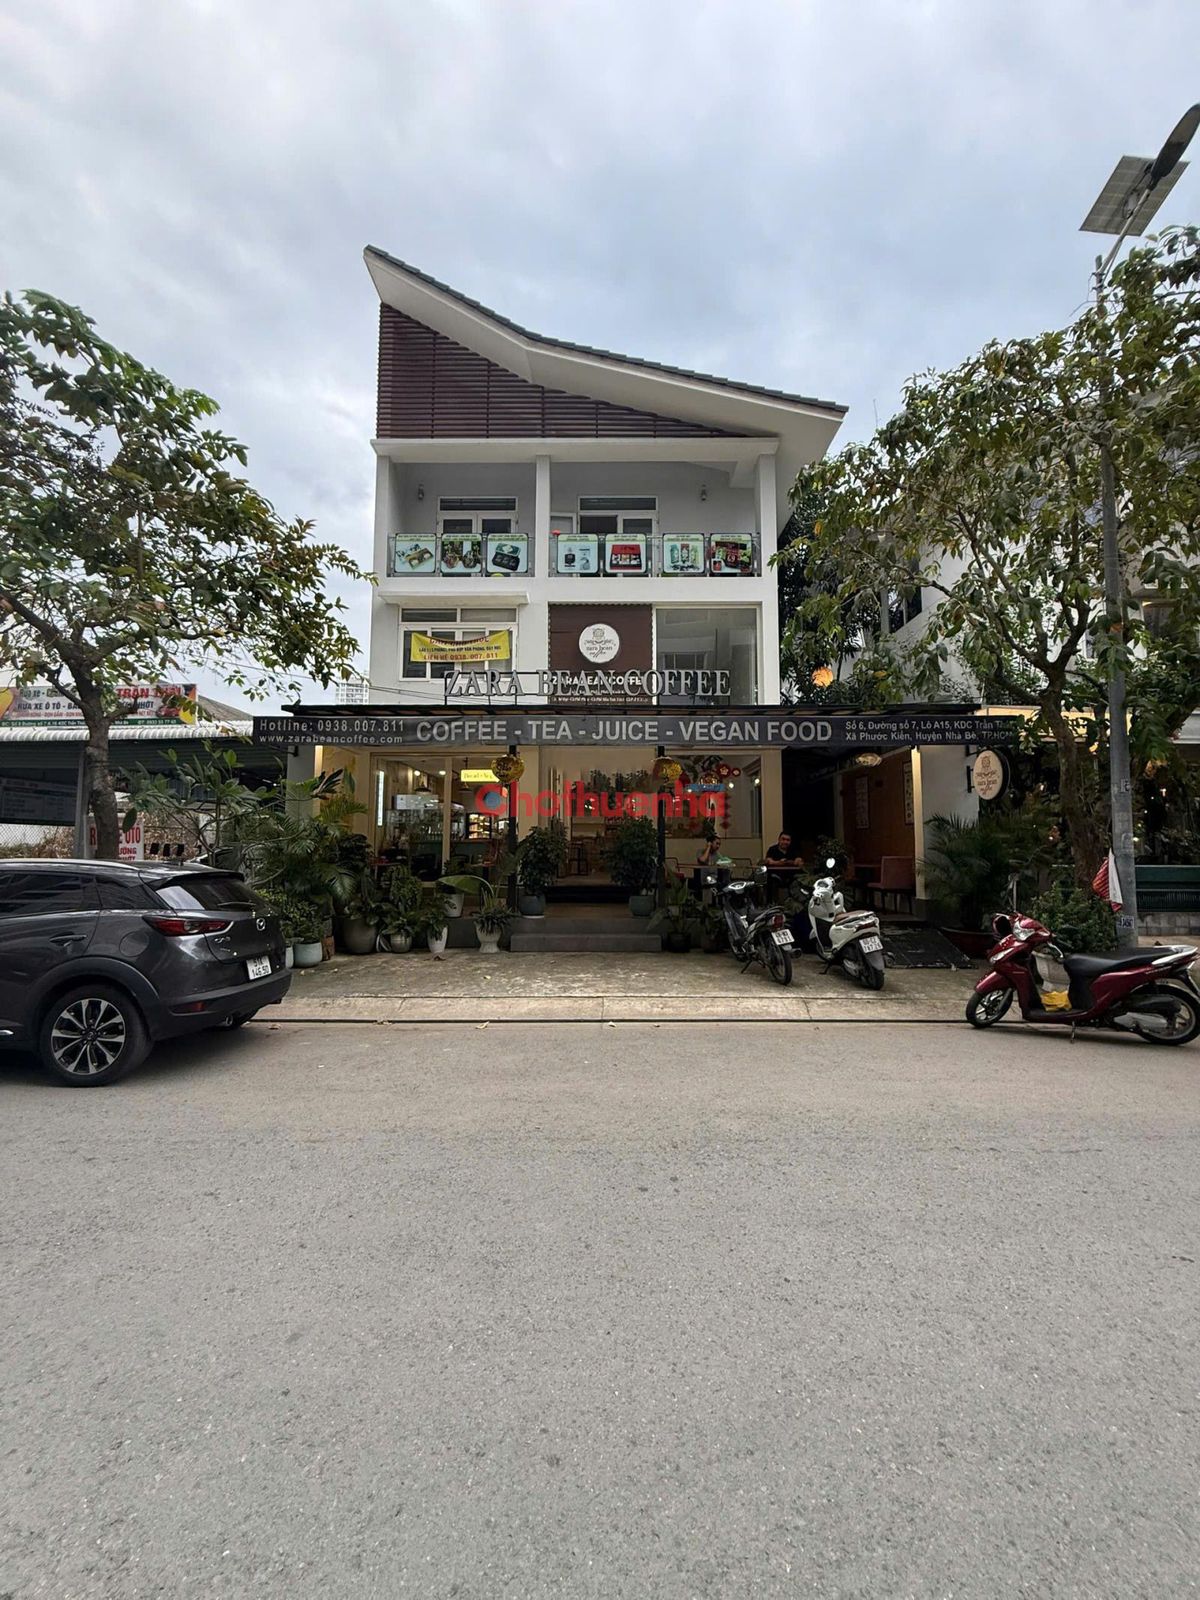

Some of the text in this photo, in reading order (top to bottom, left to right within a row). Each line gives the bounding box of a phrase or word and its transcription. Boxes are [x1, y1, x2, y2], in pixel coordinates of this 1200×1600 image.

[444, 669, 731, 697] ZARA BEAN COFFEE
[34, 702, 43, 710] XE
[260, 720, 404, 732] Hotline: 0938.007.811
[416, 720, 507, 741] COFFEE
[528, 720, 573, 740] TEA
[592, 720, 659, 740] JUICE
[679, 721, 759, 741] VEGAN
[767, 721, 832, 741] FOOD
[845, 719, 857, 730] Số
[858, 721, 867, 731] 6,
[868, 720, 897, 731] Đường
[899, 719, 910, 730] số
[911, 721, 919, 730] 7,
[954, 720, 973, 729] KDC
[259, 734, 403, 744] www.zarabeancoffee.com
[860, 731, 888, 740] Phước
[915, 731, 942, 742] Huyện
[945, 731, 962, 740] Nhà
